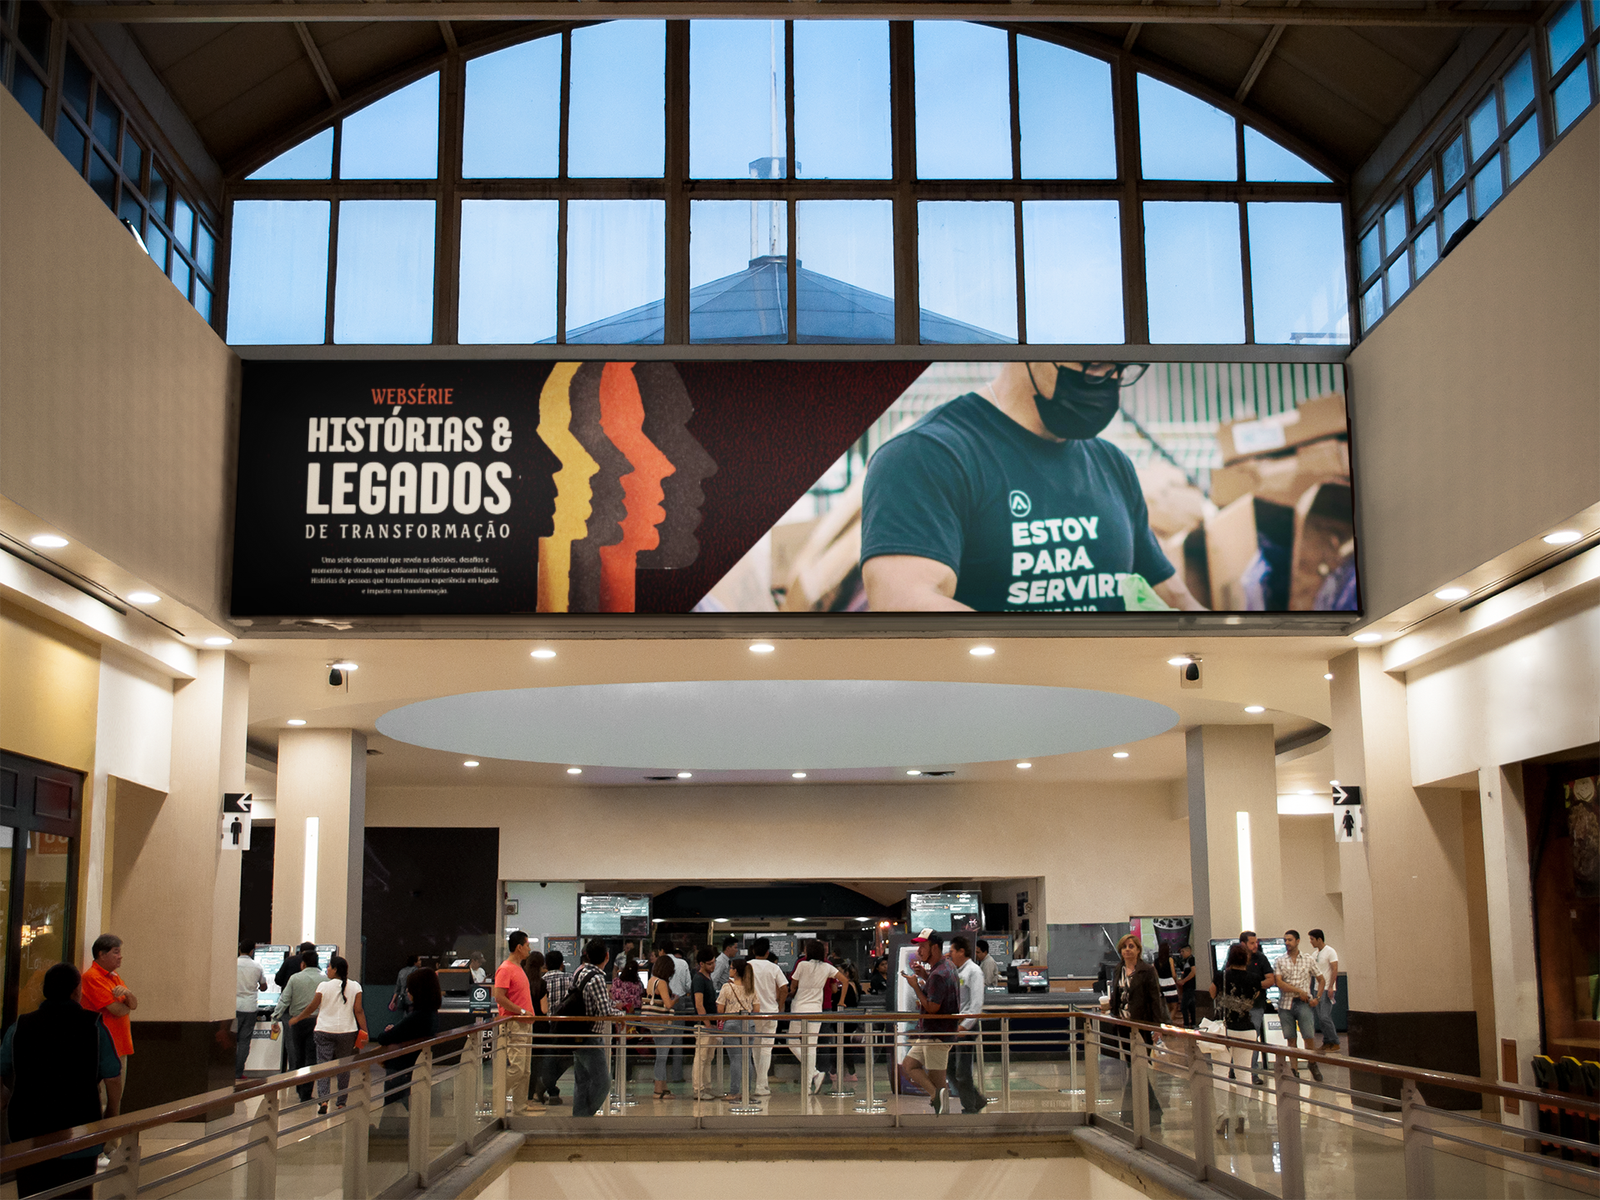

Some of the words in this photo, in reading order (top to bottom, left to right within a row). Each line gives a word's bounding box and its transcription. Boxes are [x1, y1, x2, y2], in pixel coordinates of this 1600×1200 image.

[371, 384, 454, 406] WEBSÉRIE
[307, 406, 483, 453] HISTÓRIAS
[492, 417, 512, 453] &
[305, 461, 512, 515] LEGADOS
[305, 524, 329, 539] DE
[340, 520, 511, 543] TRANSFORMAÇÃO
[1011, 516, 1099, 547] ESTOY
[311, 567, 343, 575] momentos
[344, 567, 352, 575] de
[353, 567, 373, 575] virada
[387, 567, 418, 575] moldaram
[419, 567, 450, 575] trajetórias
[321, 556, 336, 564] Uma
[337, 556, 352, 564] série
[353, 556, 389, 564] documental
[403, 556, 422, 564] revela
[431, 556, 458, 564] decisões,
[459, 556, 484, 564] desafios
[1011, 545, 1095, 577] PARA
[311, 577, 337, 585] Histórias
[339, 577, 347, 585] de
[348, 577, 371, 585] pessoas
[386, 577, 430, 585] transformaram
[431, 577, 466, 585] experiência
[478, 577, 499, 585] legado
